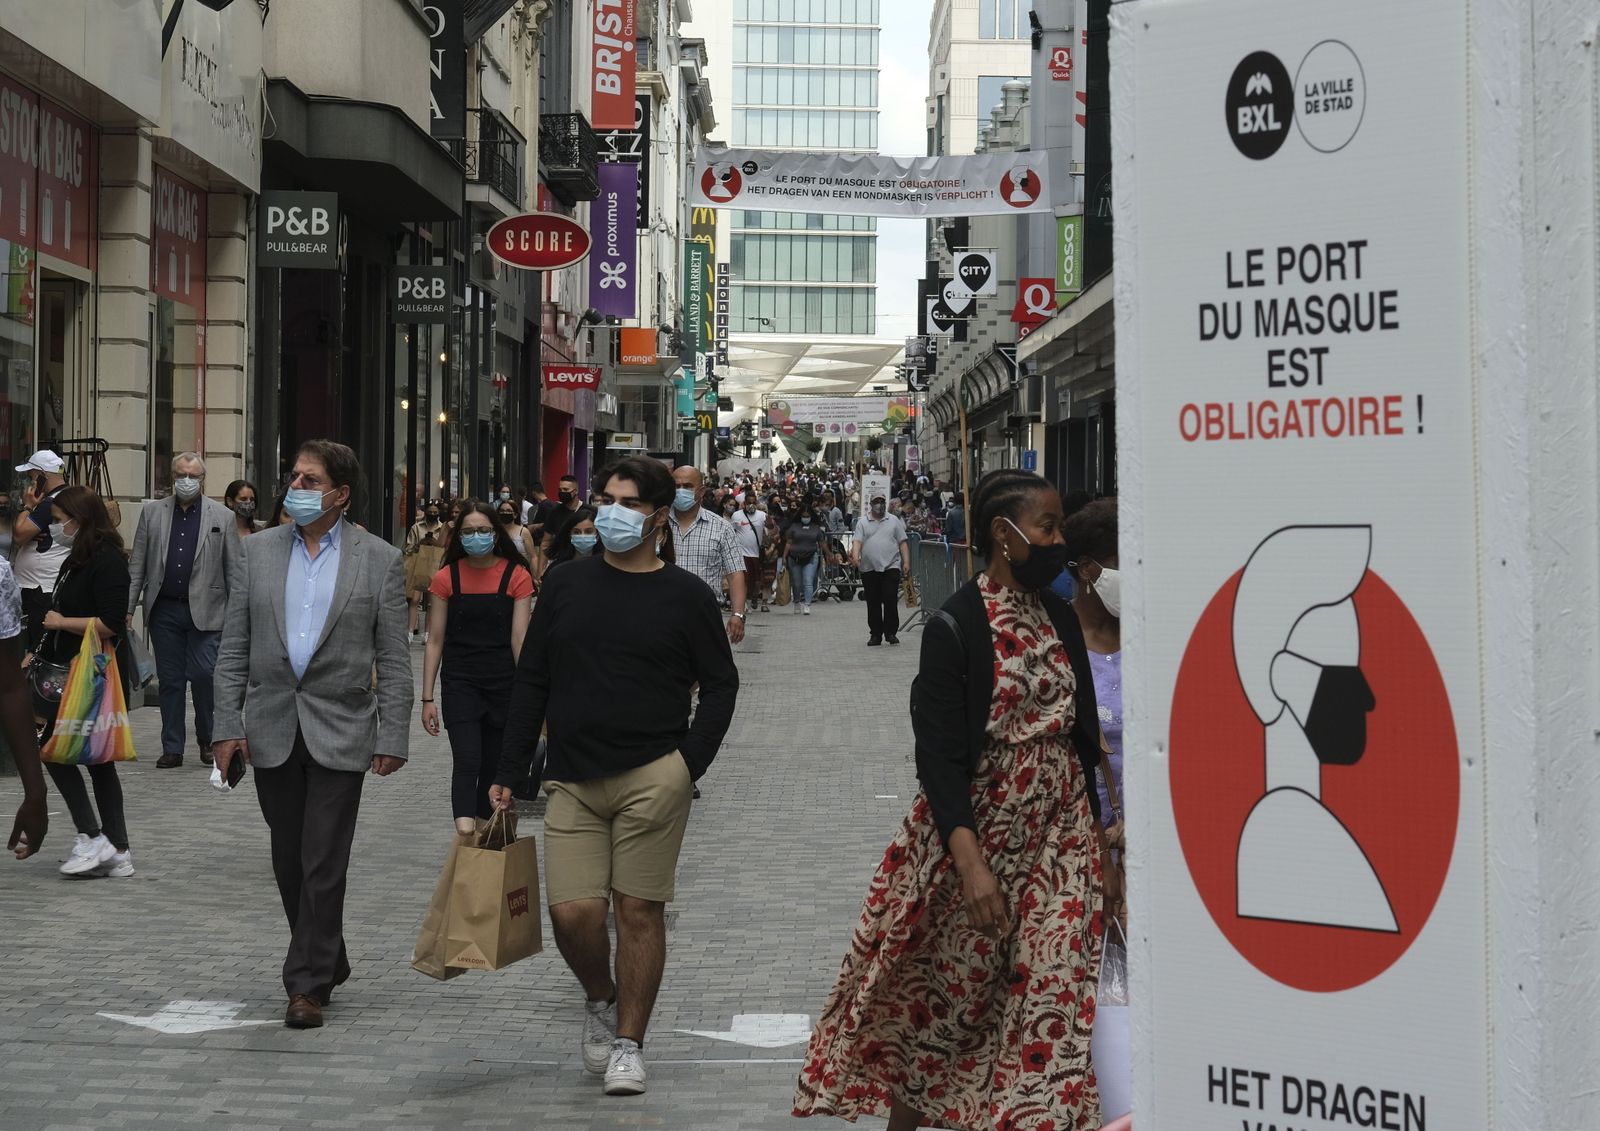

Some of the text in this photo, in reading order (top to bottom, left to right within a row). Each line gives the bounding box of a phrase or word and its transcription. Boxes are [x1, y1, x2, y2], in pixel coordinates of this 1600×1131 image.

[1053, 71, 1070, 79] Quick
[1304, 79, 1354, 98] LA VILLE
[1238, 103, 1281, 134] BXL
[1305, 96, 1353, 114] DE STAD
[0, 86, 82, 188] STOCK BAG
[747, 186, 994, 201] HET DRAGEN VAN EEN MONDMASKER IS VERPLICHT !
[776, 175, 966, 189] LE PORT DU MASQUE EST OBLIGATOIRE !
[178, 186, 198, 243] BAG
[266, 206, 330, 236] P&B
[607, 192, 618, 256] proximus
[266, 241, 328, 253] PULL&BEAR
[505, 229, 573, 252] SCORE
[1063, 223, 1075, 287] casa
[1226, 240, 1368, 289] LE PORT
[690, 250, 702, 292] BARRETT
[961, 265, 990, 277] CITY
[397, 276, 446, 300] P&B
[397, 304, 445, 313] PULL&BEAR
[1199, 290, 1399, 341] DU MASQUE
[622, 353, 653, 365] orange
[1268, 347, 1330, 388] EST
[1179, 394, 1424, 442] OBLIGATOIRE !
[53, 711, 130, 737] ZEEMAN
[1208, 1064, 1426, 1131] HET DRAGEN
